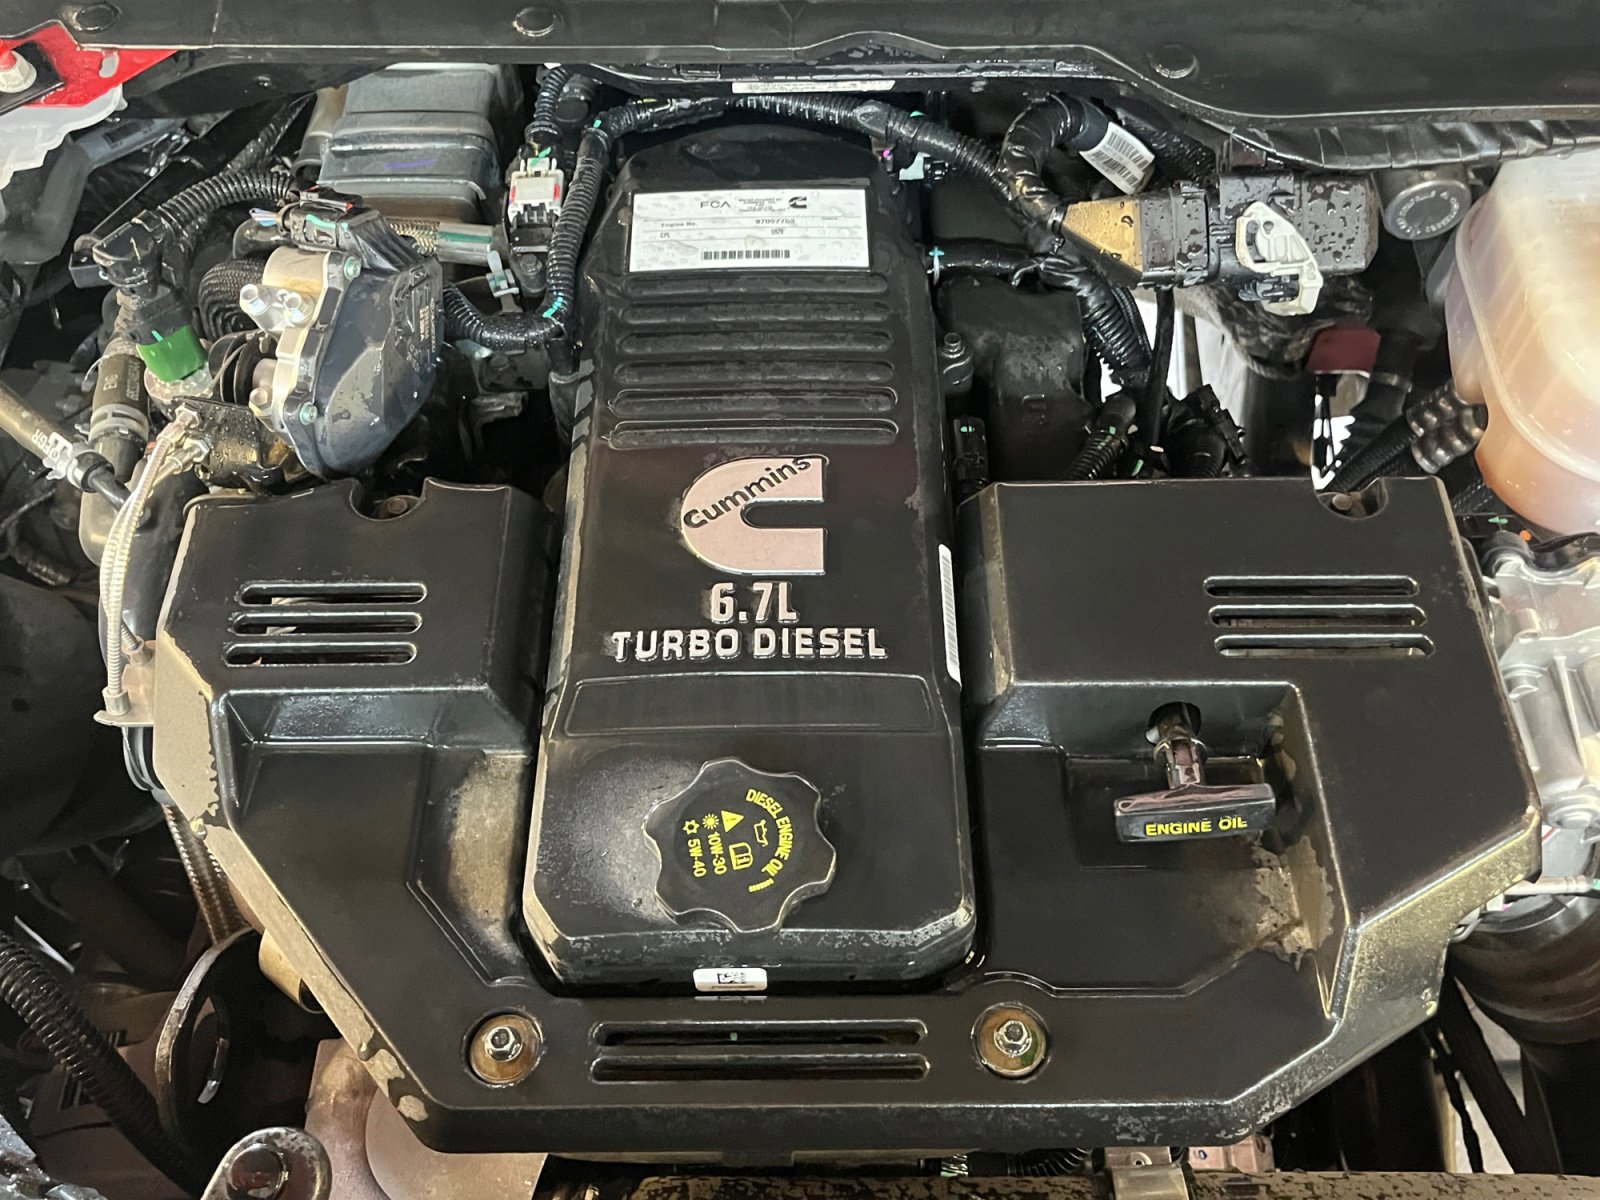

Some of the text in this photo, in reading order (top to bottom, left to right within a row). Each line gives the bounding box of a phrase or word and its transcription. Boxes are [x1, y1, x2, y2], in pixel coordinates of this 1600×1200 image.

[699, 200, 732, 209] FCA
[683, 457, 811, 528] Cummins
[710, 582, 798, 623] 6.7L
[612, 627, 888, 662] TURBO DIESEL
[745, 788, 783, 819] DIESEL
[774, 816, 794, 860] ENGINE
[1145, 816, 1248, 836] ENGINE OIL
[687, 838, 707, 878] 5W-40
[707, 831, 728, 875] 10W-30
[761, 858, 783, 877] OIL
